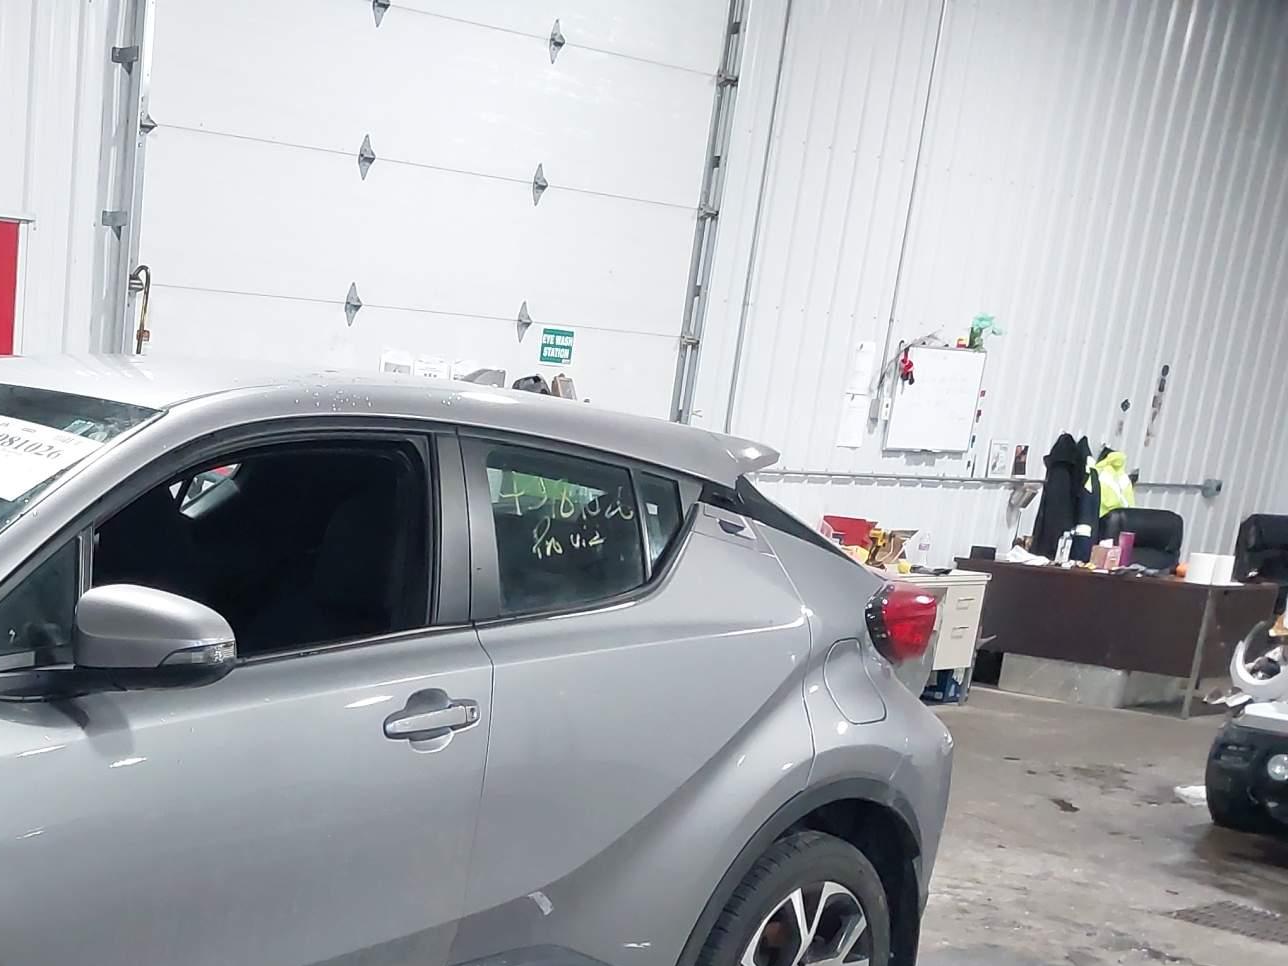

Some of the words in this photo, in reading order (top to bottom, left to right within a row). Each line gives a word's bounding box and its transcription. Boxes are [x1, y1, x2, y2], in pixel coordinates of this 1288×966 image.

[542, 334, 556, 345] EYE
[556, 335, 573, 347] WASH
[542, 346, 570, 359] STATION
